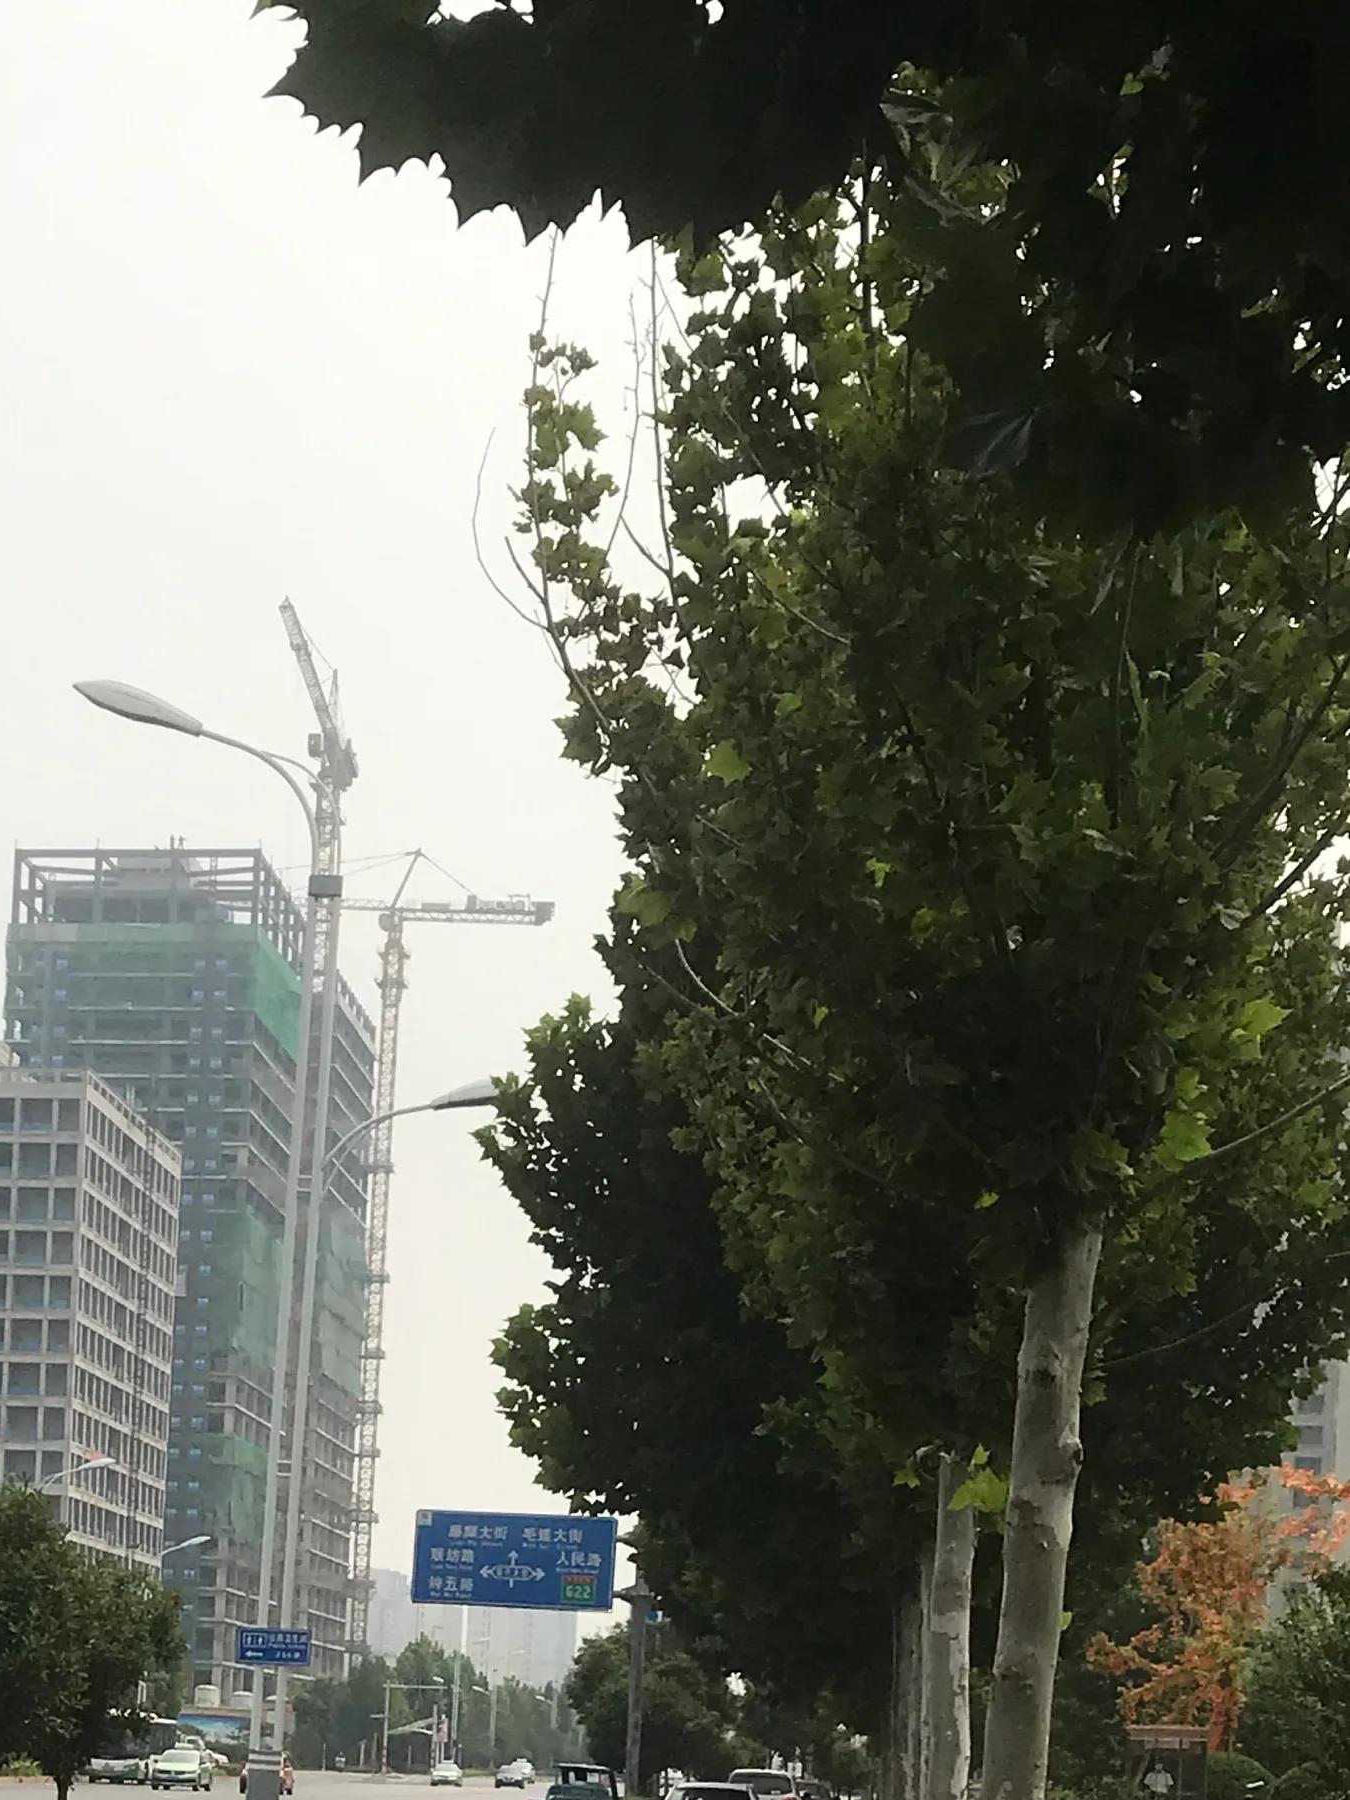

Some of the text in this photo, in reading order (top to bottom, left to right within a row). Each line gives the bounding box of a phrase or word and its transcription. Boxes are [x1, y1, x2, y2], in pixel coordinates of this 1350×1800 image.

[555, 1551, 602, 1566] 人民路
[566, 1585, 591, 1599] G22
